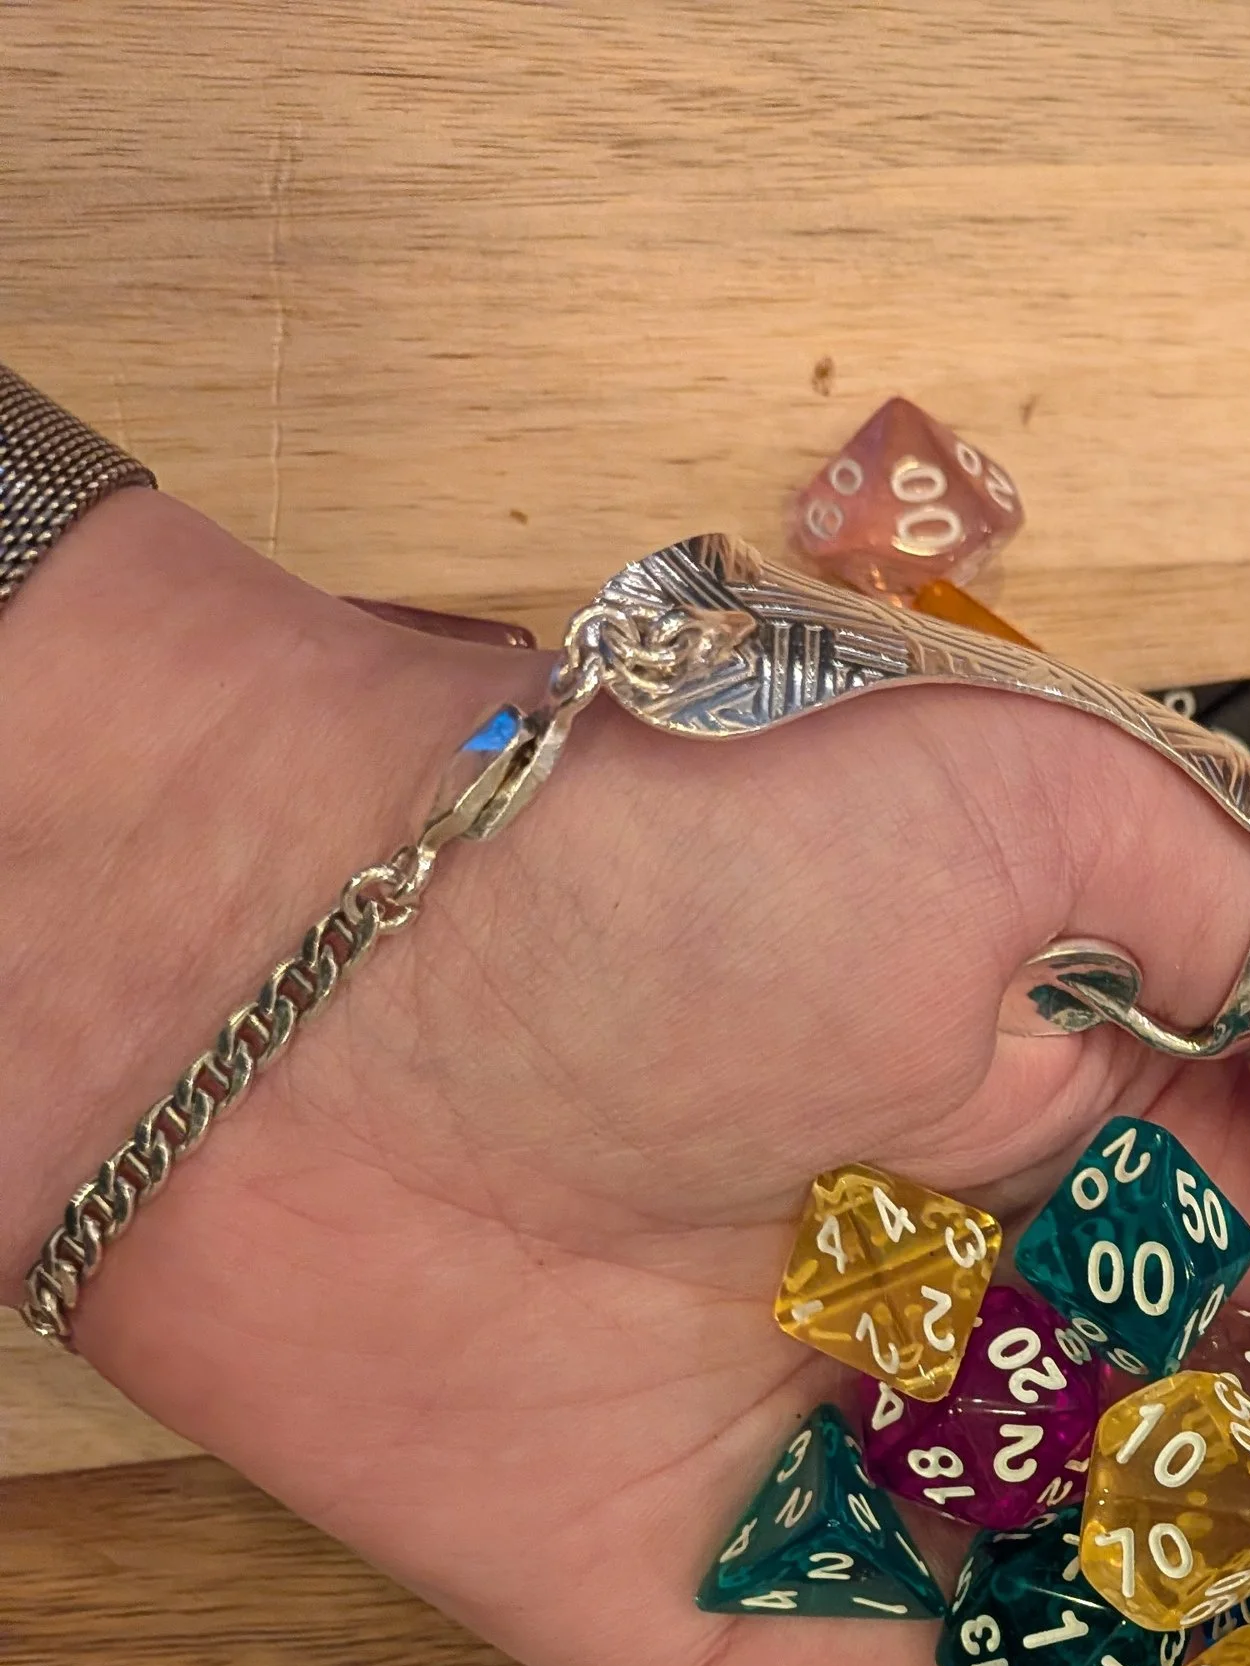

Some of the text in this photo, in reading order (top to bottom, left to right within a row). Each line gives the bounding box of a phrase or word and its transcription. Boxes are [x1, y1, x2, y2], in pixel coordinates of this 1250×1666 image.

[891, 458, 961, 556] 00
[1071, 1128, 1152, 1211] 20
[873, 1186, 917, 1243] 4
[1176, 1168, 1228, 1251] 50
[816, 1214, 849, 1275] 4
[945, 1217, 988, 1269] 3
[1088, 1240, 1175, 1317] 00
[855, 1312, 900, 1375] 2
[920, 1285, 955, 1352] 2
[1178, 1284, 1226, 1361] 10
[987, 1327, 1068, 1404] 20
[872, 1381, 904, 1431] 4
[777, 1430, 812, 1483] 3
[993, 1423, 1044, 1483] 2
[1116, 1402, 1207, 1488] 10
[907, 1446, 976, 1505] 18
[774, 1487, 813, 1529] 2
[719, 1518, 758, 1564] 4
[806, 1552, 855, 1581] 2
[1094, 1522, 1194, 1598] 70
[741, 1590, 798, 1610] 4
[852, 1597, 908, 1614] 1
[1022, 1610, 1090, 1650] 1
